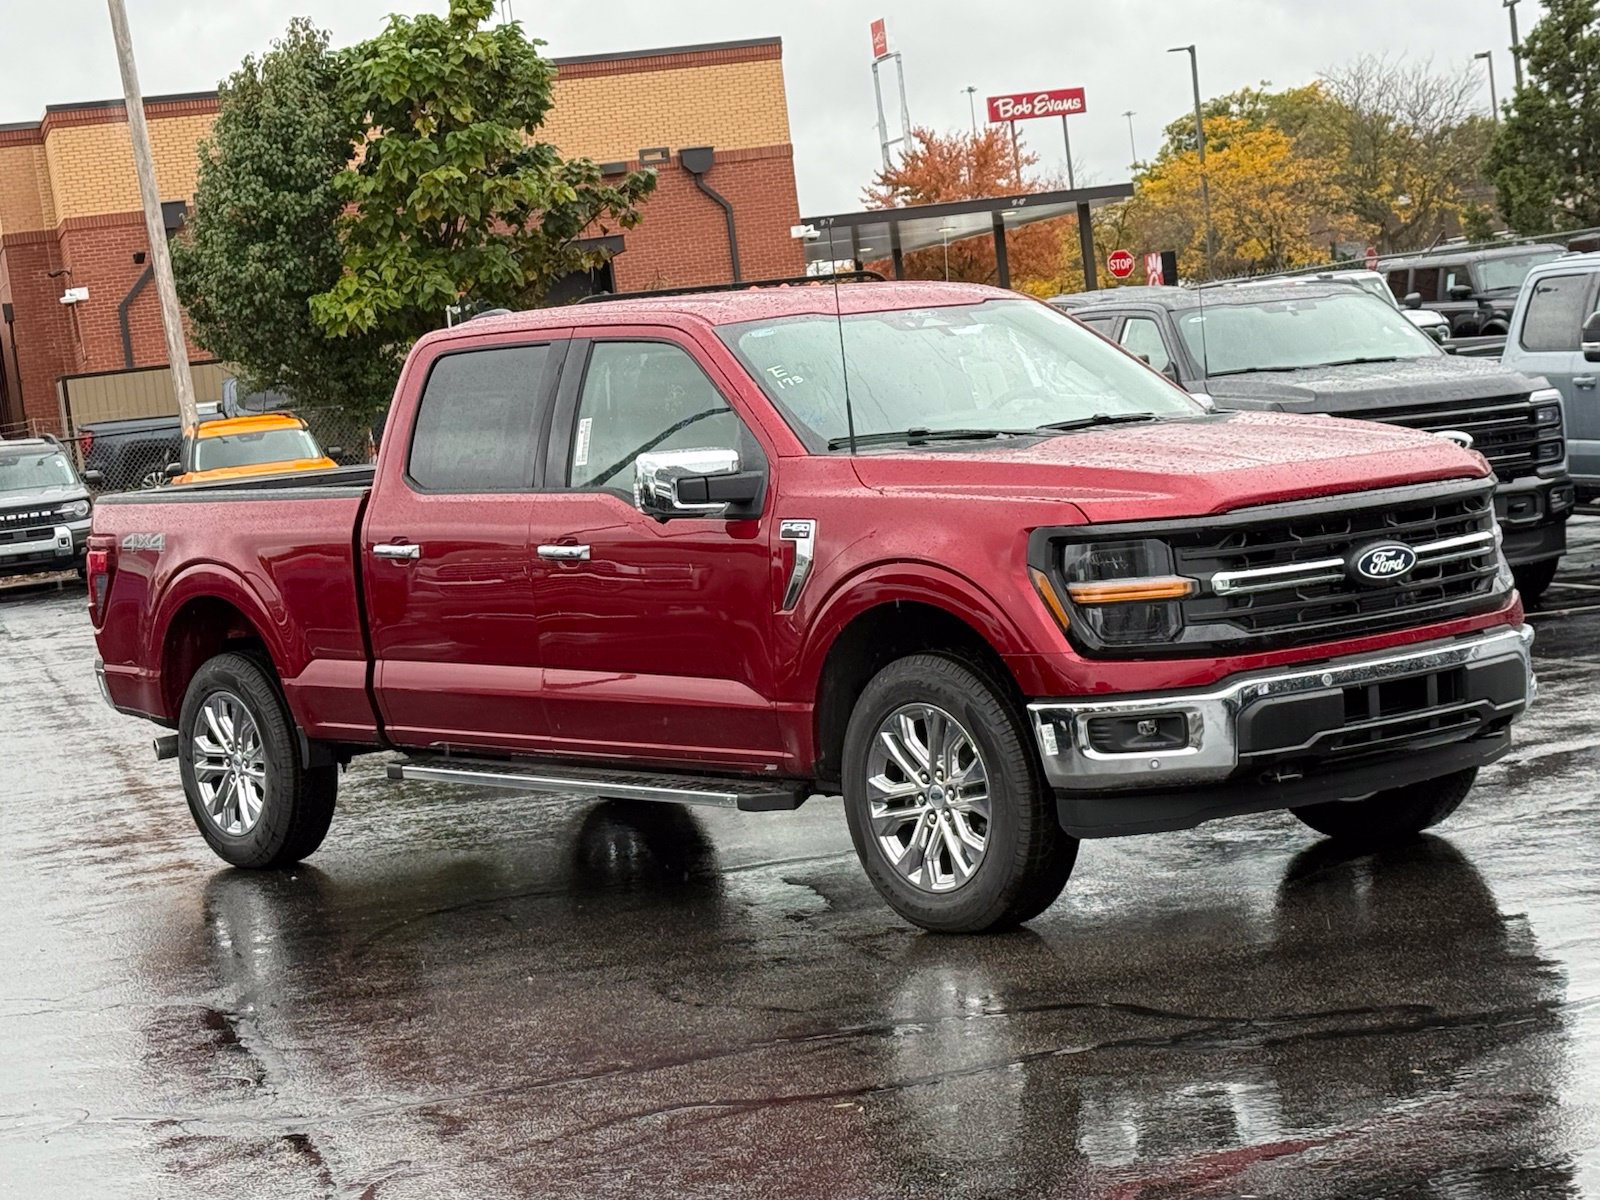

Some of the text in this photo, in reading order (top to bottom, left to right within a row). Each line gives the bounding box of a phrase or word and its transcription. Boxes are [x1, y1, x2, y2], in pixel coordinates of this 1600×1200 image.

[993, 94, 1082, 118] Bob Evans
[1110, 258, 1132, 271] STOP
[766, 365, 788, 378] E
[1369, 550, 1405, 574] Ford
